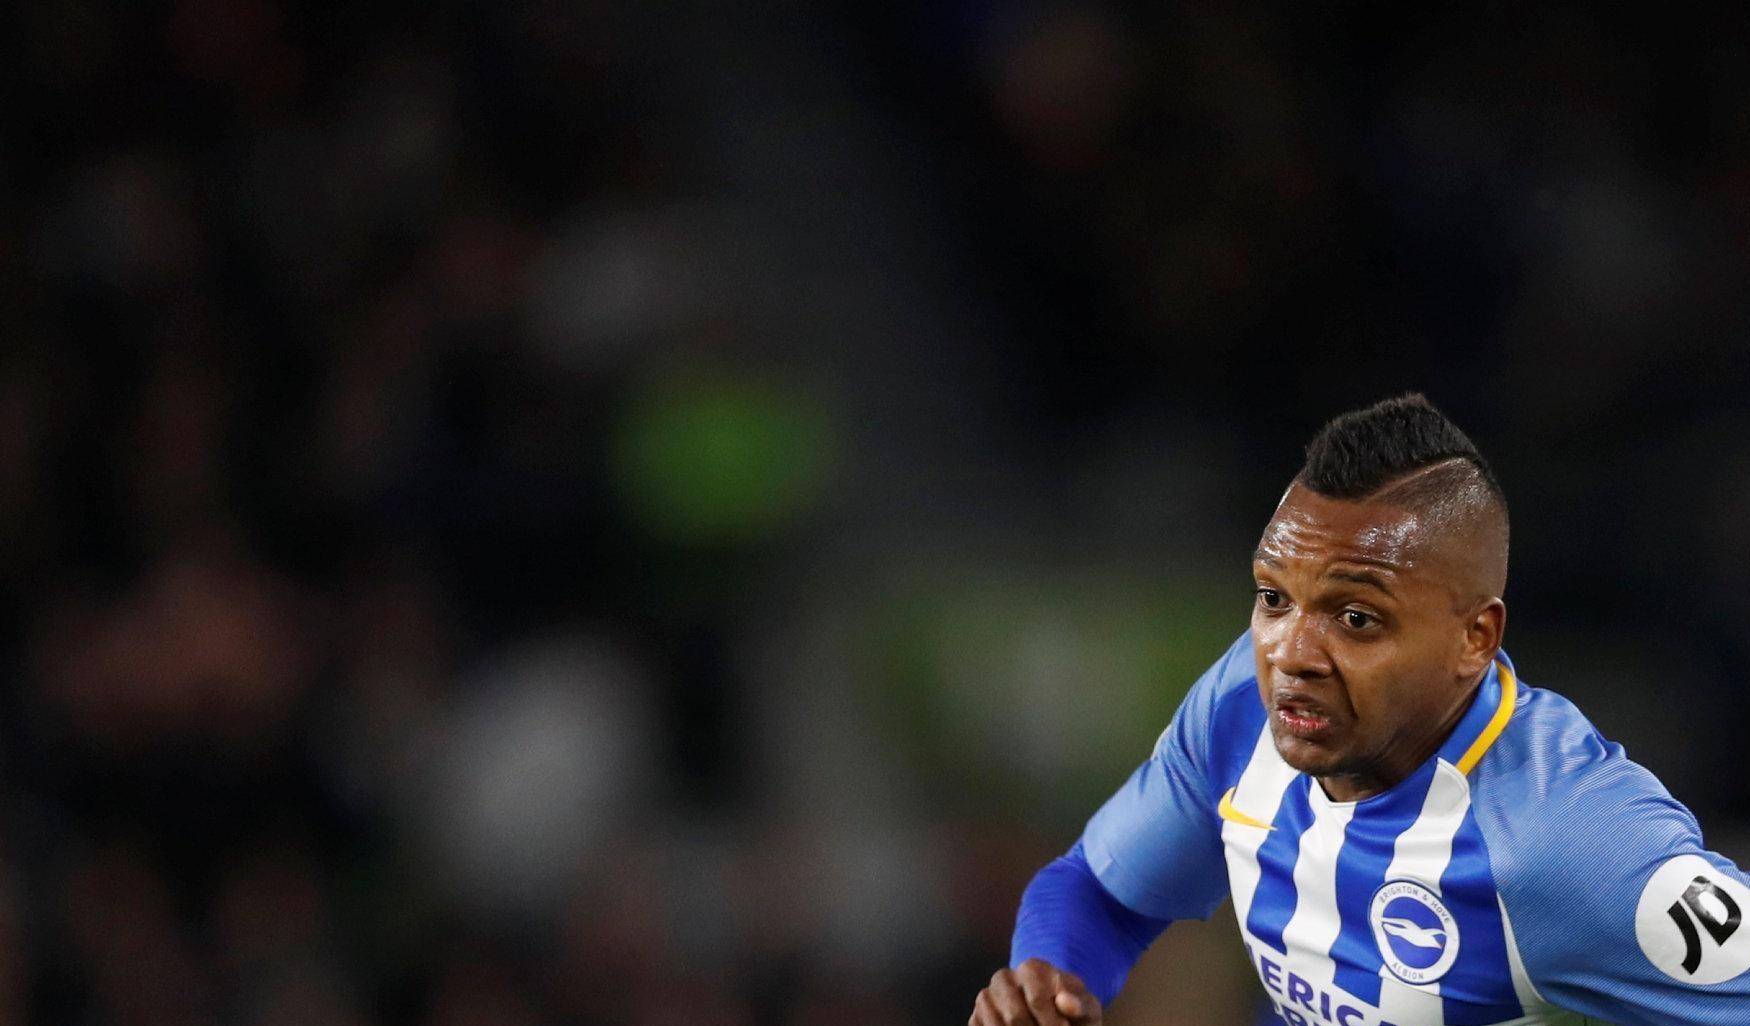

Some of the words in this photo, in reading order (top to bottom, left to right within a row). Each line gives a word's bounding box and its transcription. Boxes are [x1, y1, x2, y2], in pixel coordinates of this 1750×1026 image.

[1431, 901, 1450, 923] HOVE
[1667, 875, 1742, 976] JD
[1391, 962, 1424, 980] ALBION
